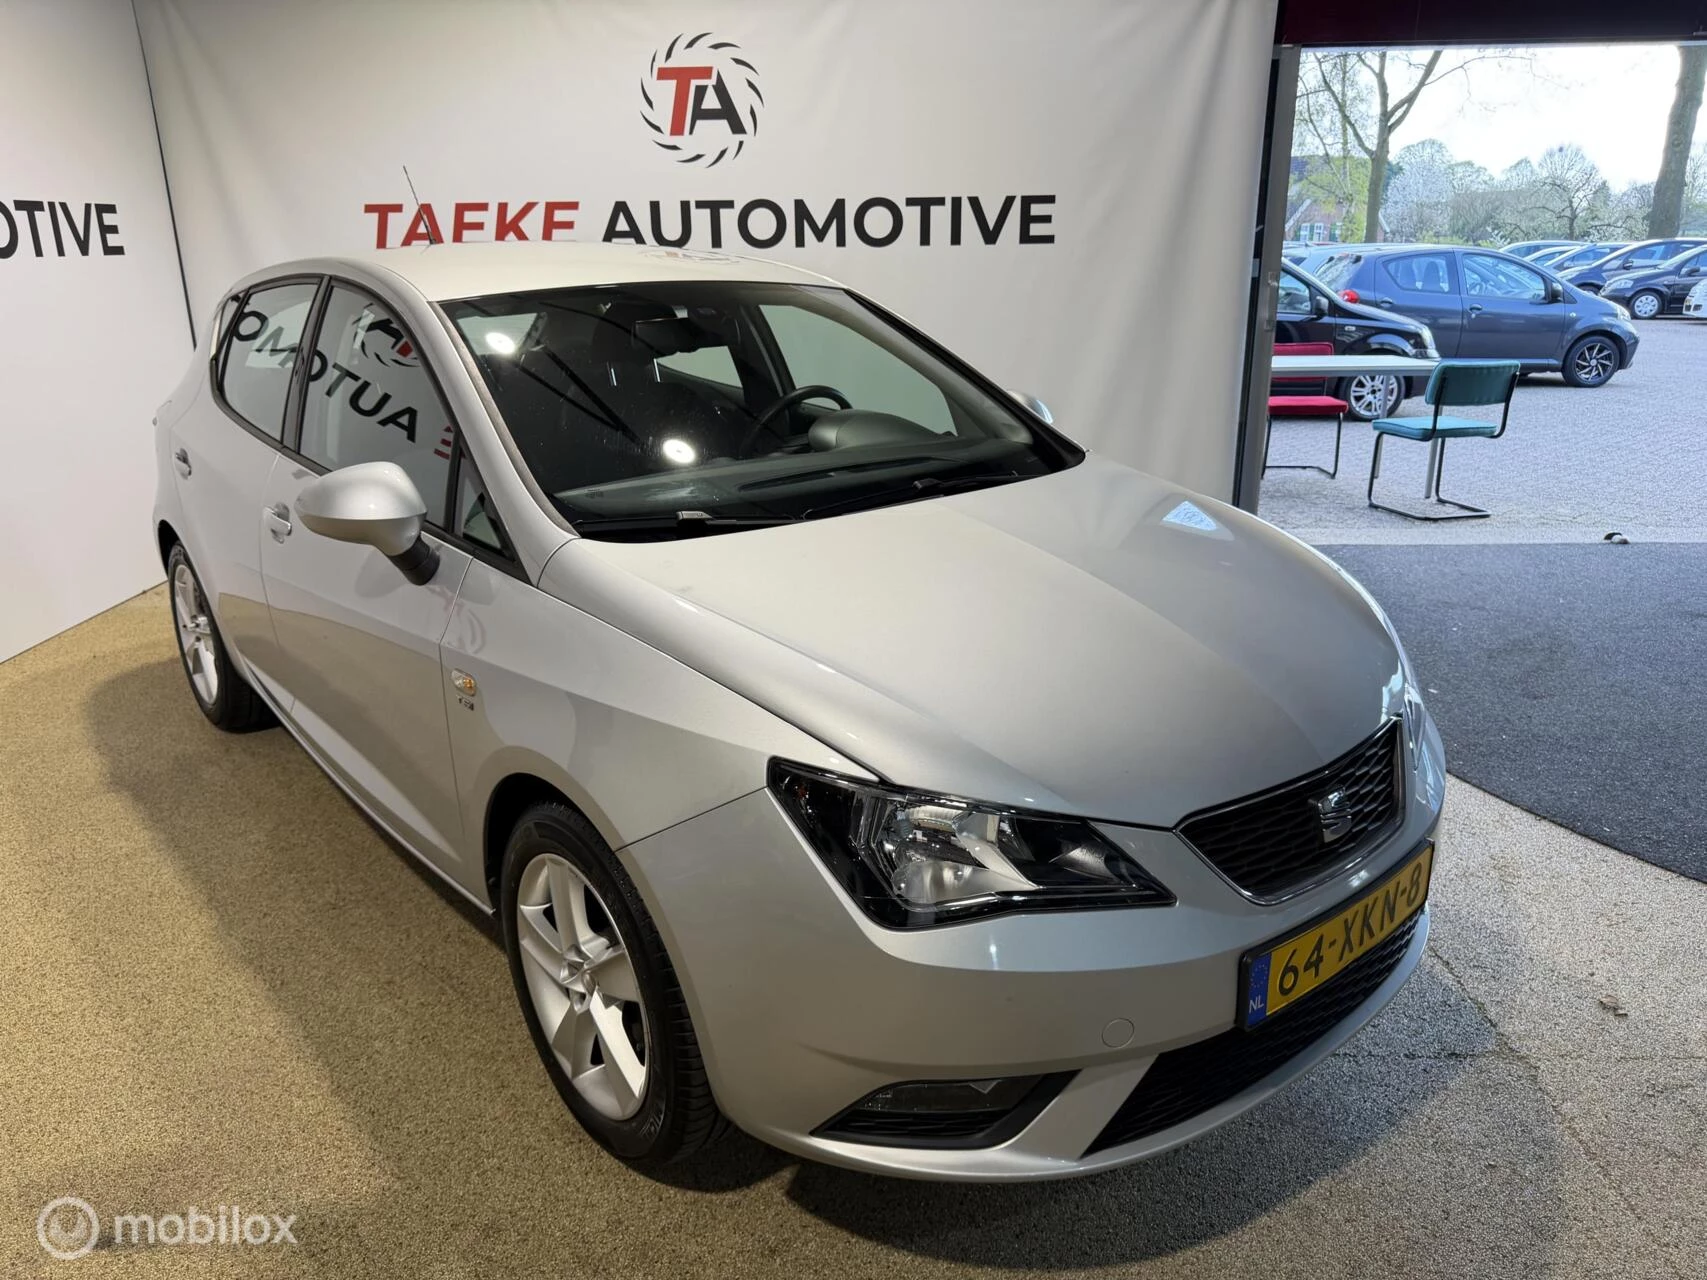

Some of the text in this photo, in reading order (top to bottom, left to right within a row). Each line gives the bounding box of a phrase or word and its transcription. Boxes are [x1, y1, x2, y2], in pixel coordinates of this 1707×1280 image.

[656, 66, 748, 136] TA
[602, 194, 1057, 249] AUTOMOTIVE
[1277, 862, 1423, 996] 64-XKN-8
[1248, 994, 1265, 1014] NL
